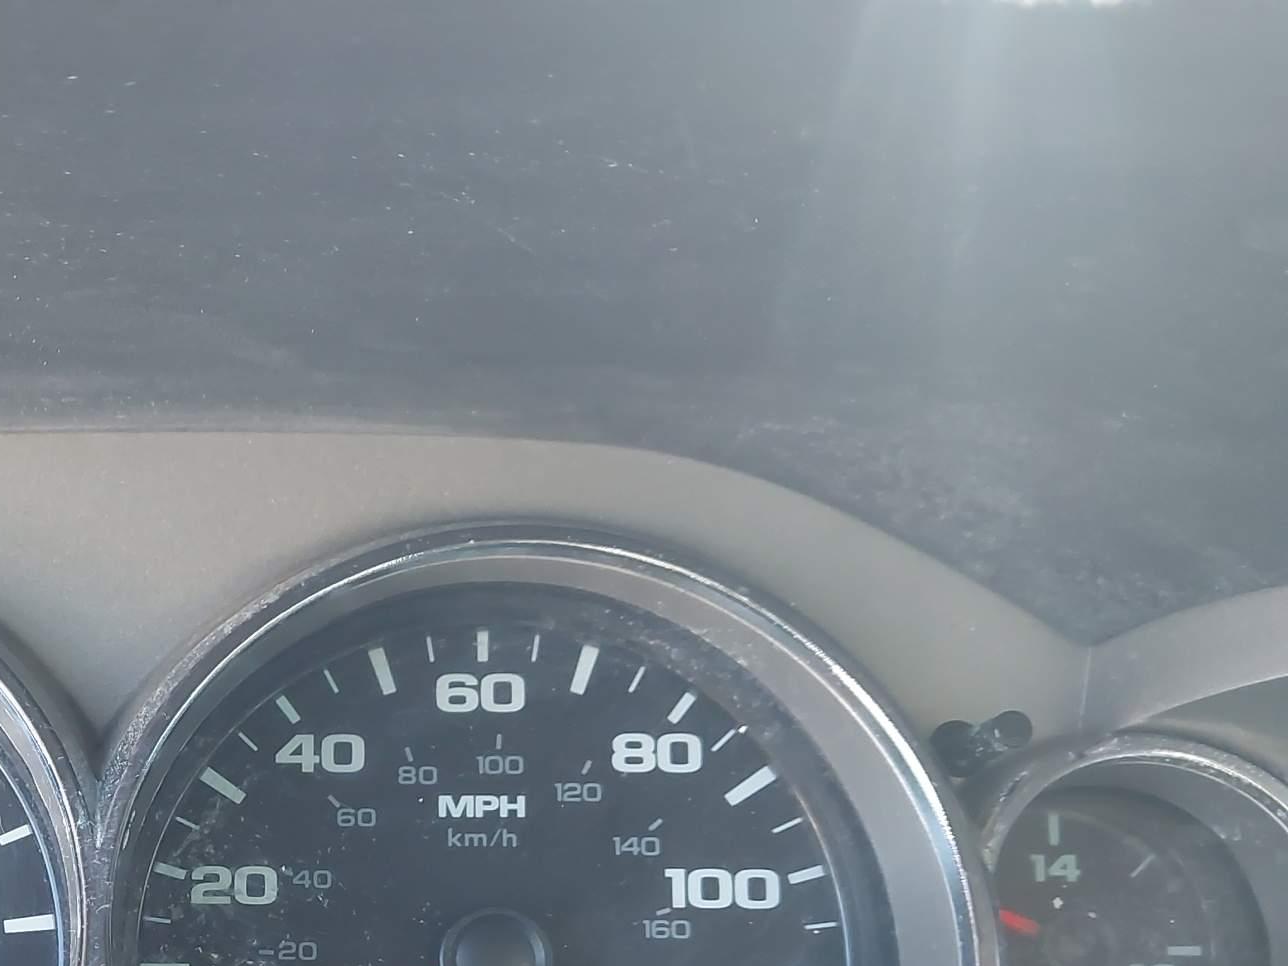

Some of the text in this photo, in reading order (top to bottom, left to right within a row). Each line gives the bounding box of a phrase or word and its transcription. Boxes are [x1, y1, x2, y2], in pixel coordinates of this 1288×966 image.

[435, 673, 525, 713] 60
[275, 733, 366, 774] 40
[611, 733, 703, 774] 80
[476, 755, 525, 775] 100
[397, 766, 439, 785] 80
[555, 783, 603, 803] 120
[438, 795, 526, 819] MPH
[335, 808, 377, 828] 60
[447, 829, 518, 849] km/h
[612, 836, 661, 856] 140
[1029, 853, 1082, 883] 14
[190, 866, 278, 905] 20
[291, 870, 332, 889] 40
[664, 868, 781, 910] 100
[642, 920, 691, 940] 160
[277, 941, 318, 962] 20
